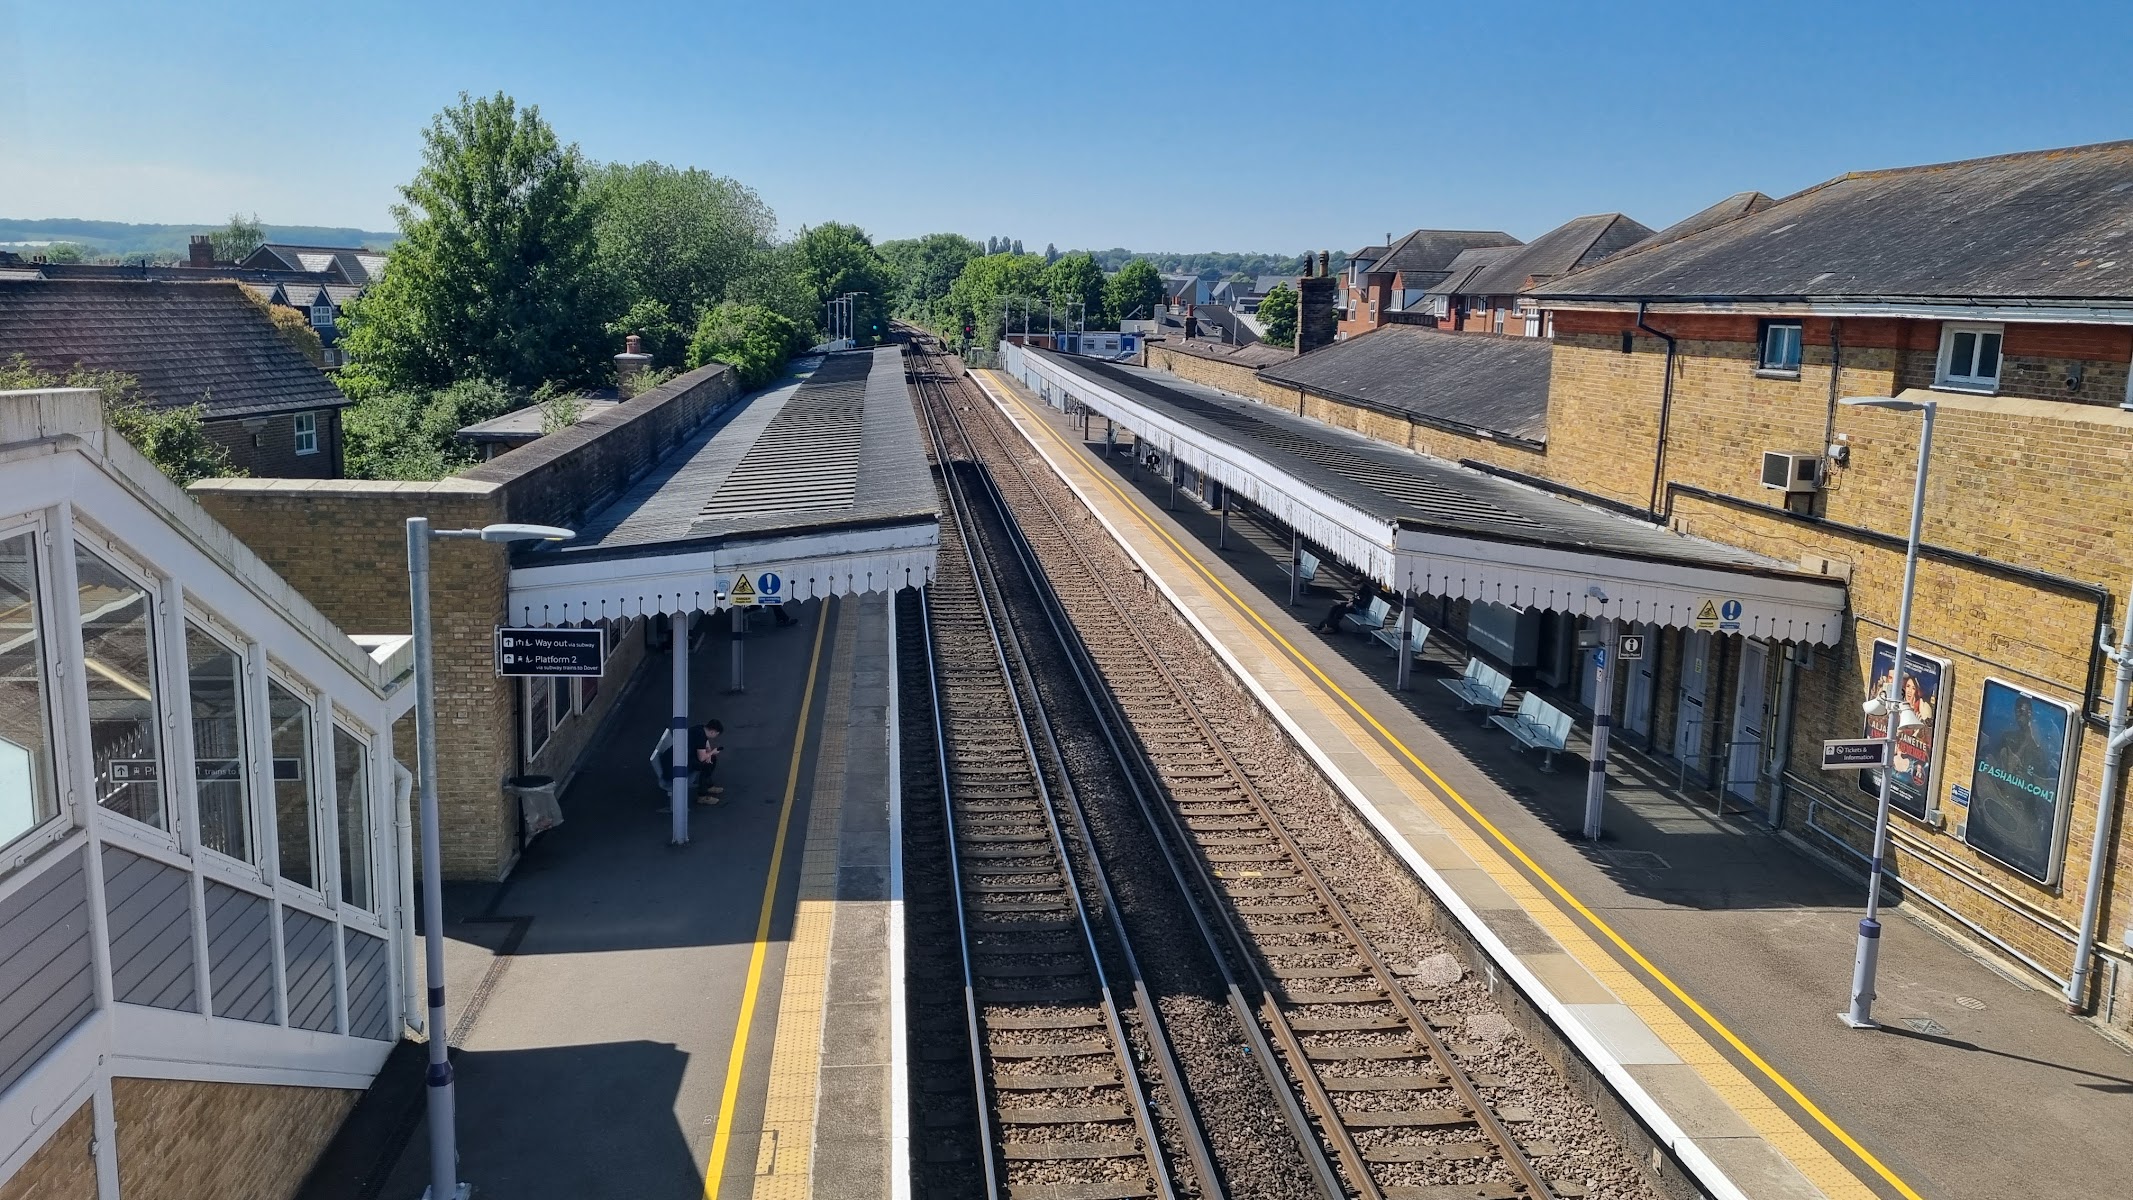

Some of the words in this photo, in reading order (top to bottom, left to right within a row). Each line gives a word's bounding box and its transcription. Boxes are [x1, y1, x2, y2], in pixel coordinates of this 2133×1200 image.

[535, 639, 552, 648] Way
[553, 639, 567, 647] out
[535, 655, 570, 663] Platform
[571, 655, 577, 663] 2
[1871, 721, 1889, 734] ALJA
[1900, 733, 1926, 752] JANETTE
[204, 767, 227, 775] trains
